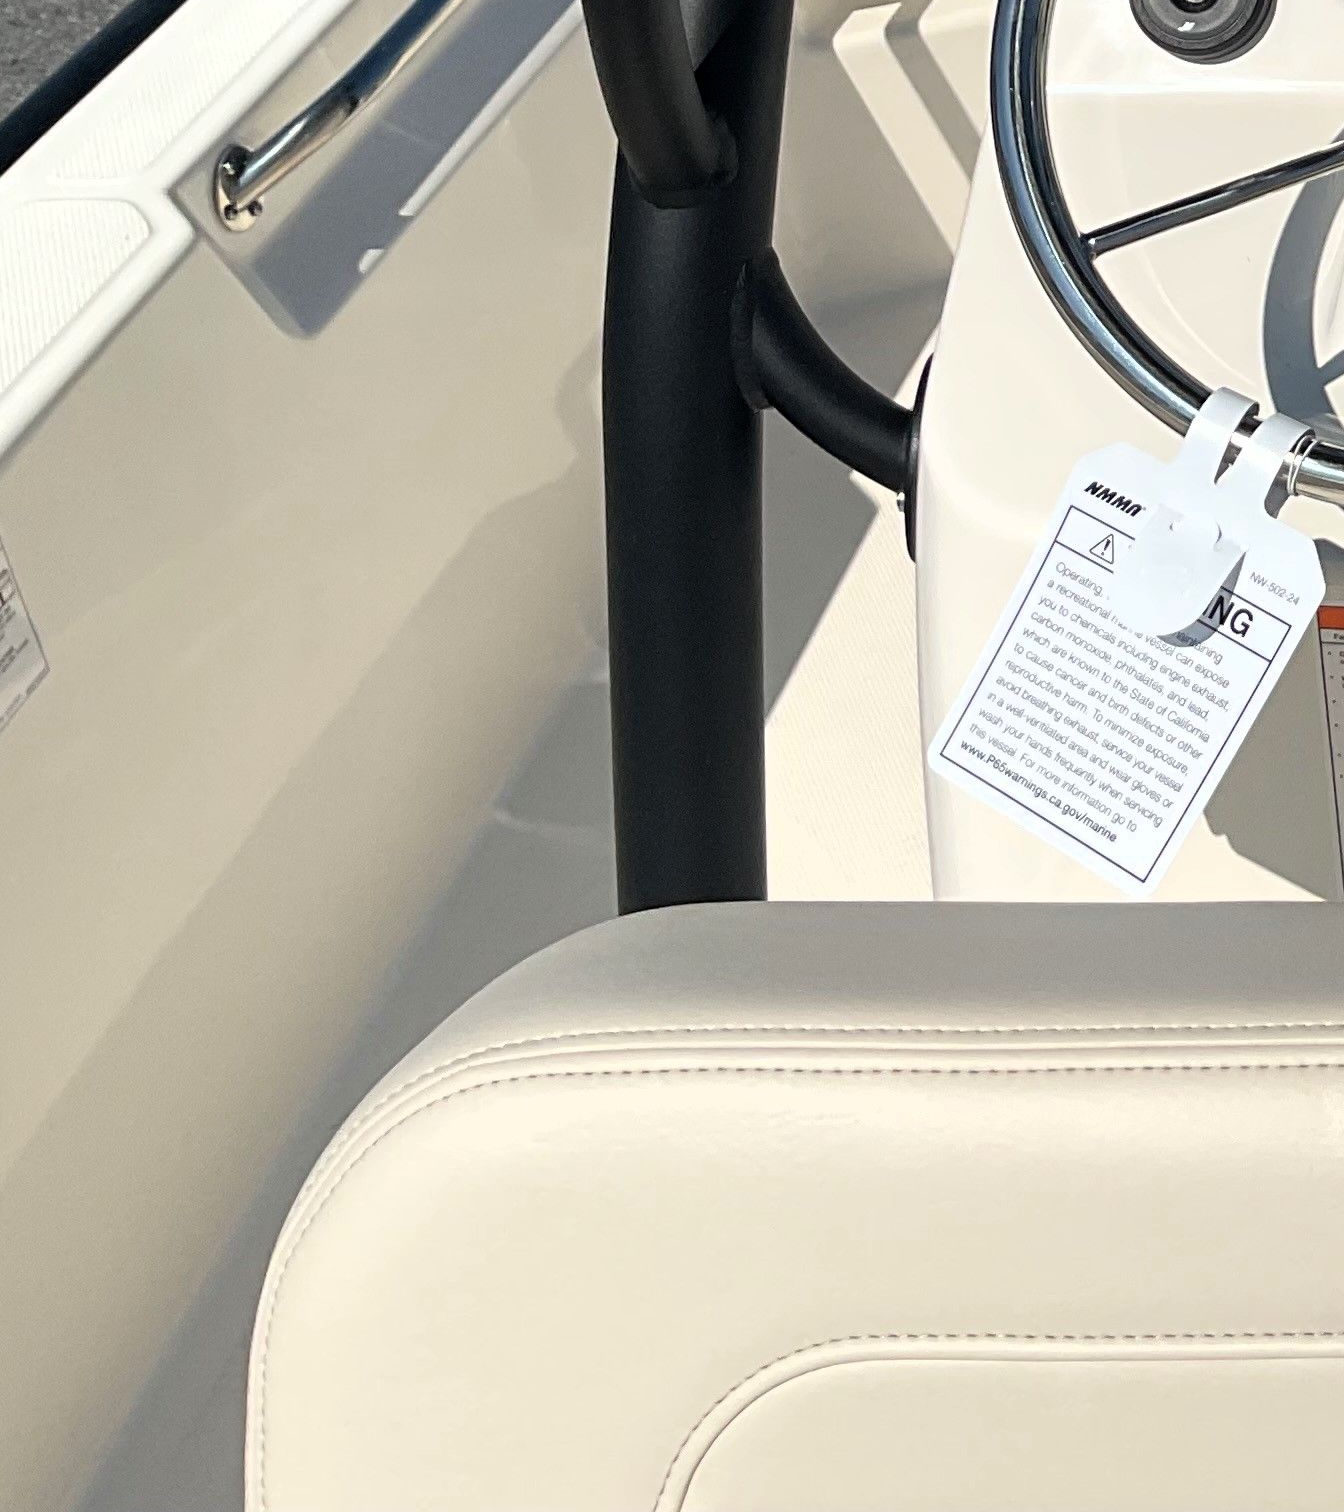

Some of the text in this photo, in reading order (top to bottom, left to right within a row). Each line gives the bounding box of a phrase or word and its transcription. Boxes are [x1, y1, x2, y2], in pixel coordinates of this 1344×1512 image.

[1249, 571, 1299, 605] NW-502-24
[1022, 627, 1210, 743] which are known to the State of California
[1037, 595, 1057, 610] you
[1058, 602, 1068, 617] to
[1069, 613, 1116, 644] chemicals
[1116, 639, 1159, 670] including
[1156, 664, 1190, 687] engine
[1145, 634, 1177, 656] vessel
[1175, 652, 1193, 667] can
[1194, 663, 1229, 688] expose
[1013, 642, 1203, 759] to cause cancer and birth defects or other
[960, 740, 1116, 842] www.P65warnings.ca.gov/marine
